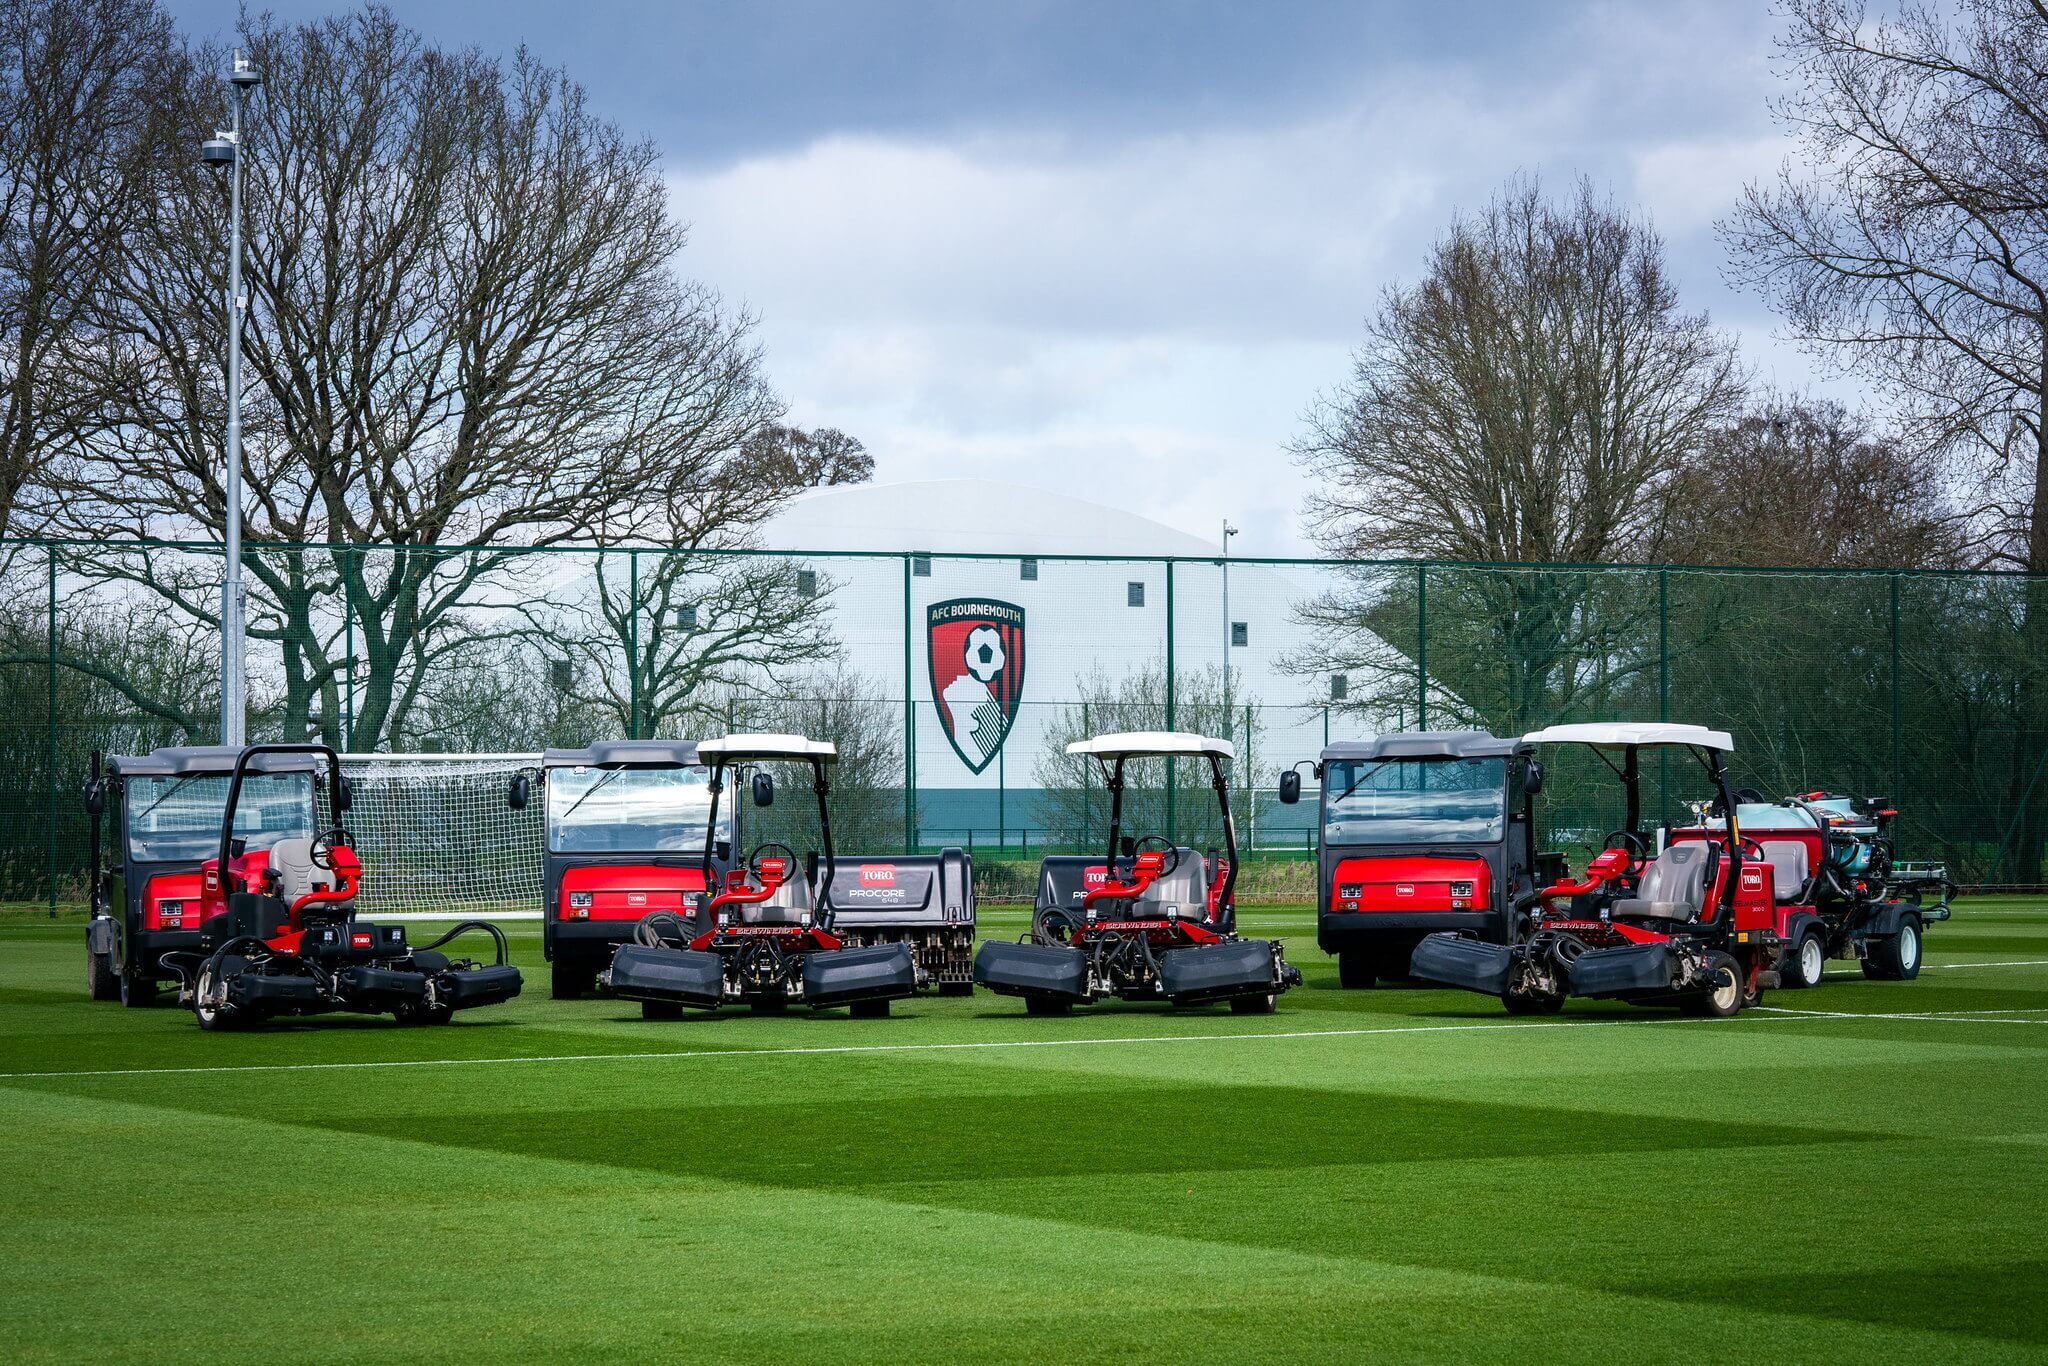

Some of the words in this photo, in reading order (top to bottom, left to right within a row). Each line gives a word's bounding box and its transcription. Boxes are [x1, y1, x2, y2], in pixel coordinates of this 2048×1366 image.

[932, 607, 949, 621] AFC
[951, 603, 1021, 623] BOURNEMOUTH
[849, 889, 906, 897] PROCORE
